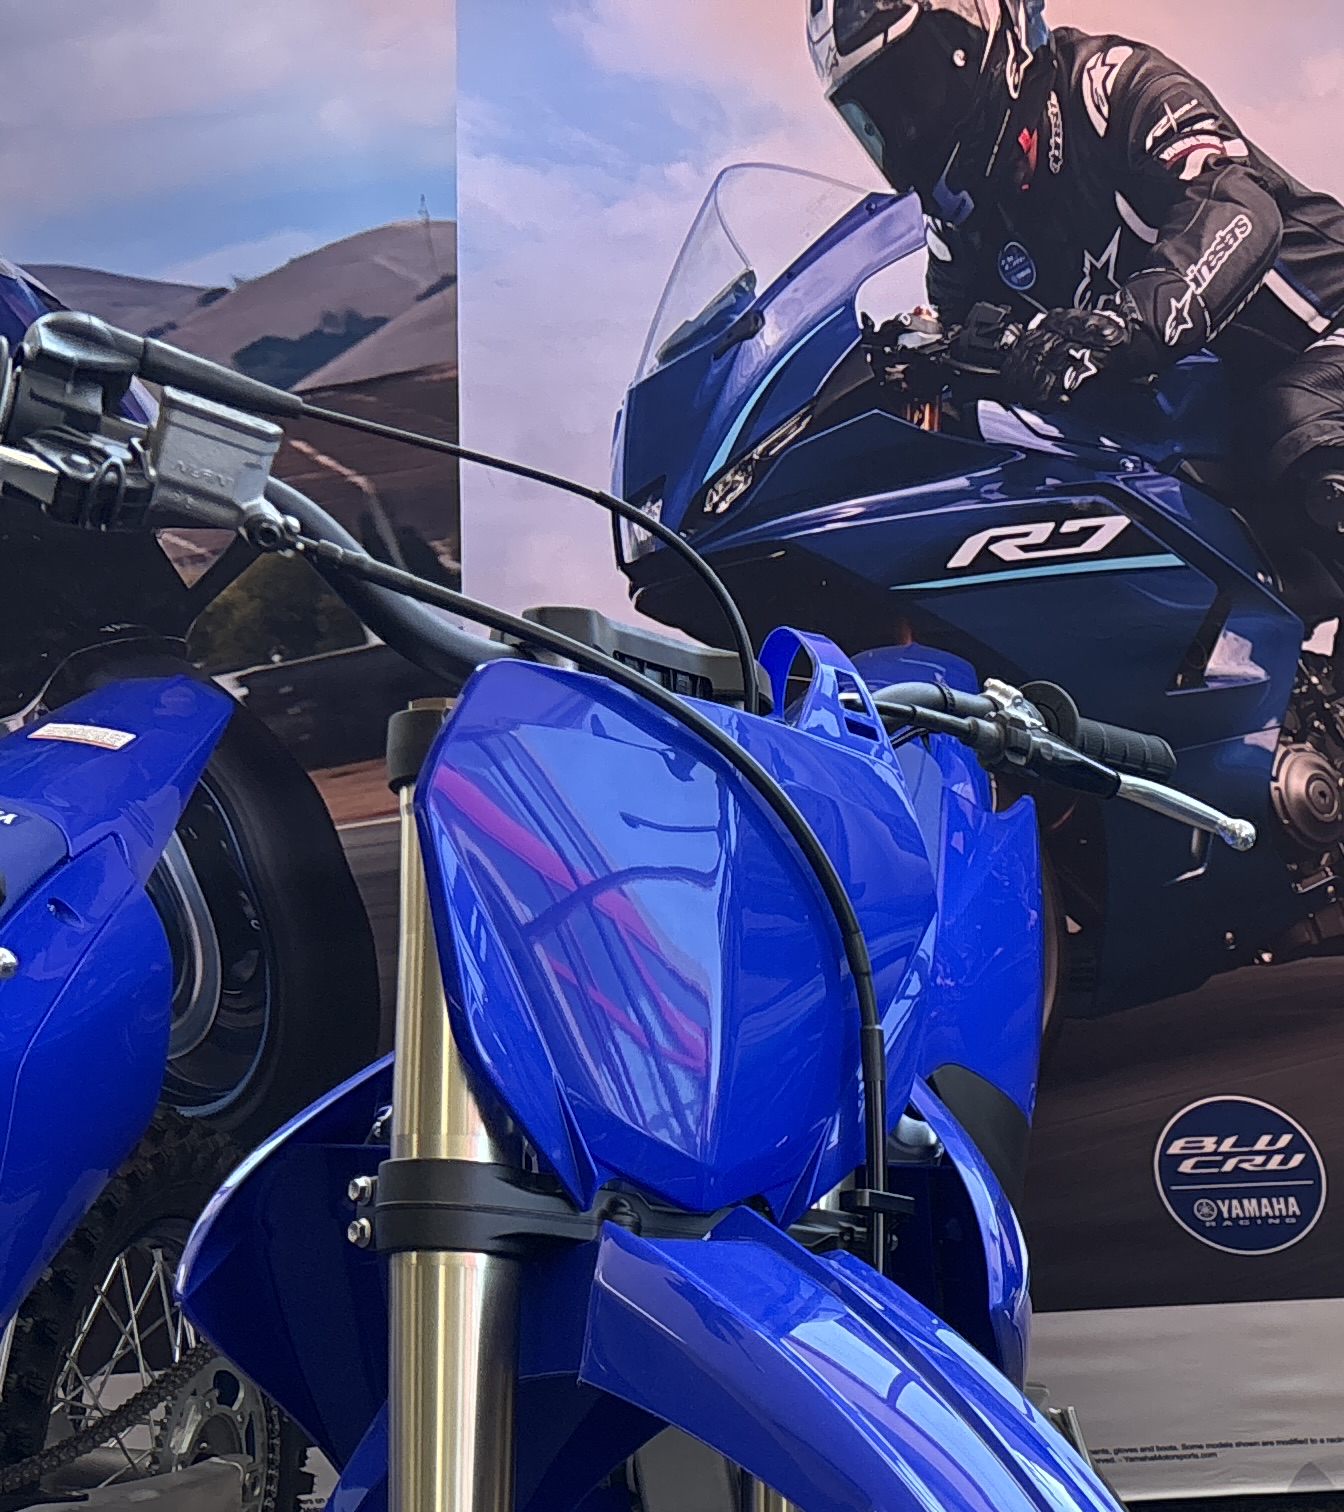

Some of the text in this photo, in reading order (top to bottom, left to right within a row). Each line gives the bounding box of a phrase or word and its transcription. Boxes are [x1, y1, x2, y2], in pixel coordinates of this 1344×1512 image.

[946, 515, 1132, 569] R7
[1165, 1133, 1294, 1155] BLU
[1176, 1153, 1306, 1174] CRU
[1216, 1197, 1301, 1218] YAMAHA
[1205, 1218, 1297, 1227] RACING
[1140, 1445, 1154, 1453] and
[1181, 1443, 1204, 1451] Some
[1206, 1441, 1233, 1449] models
[1235, 1440, 1260, 1448] shown
[1276, 1437, 1308, 1446] modified
